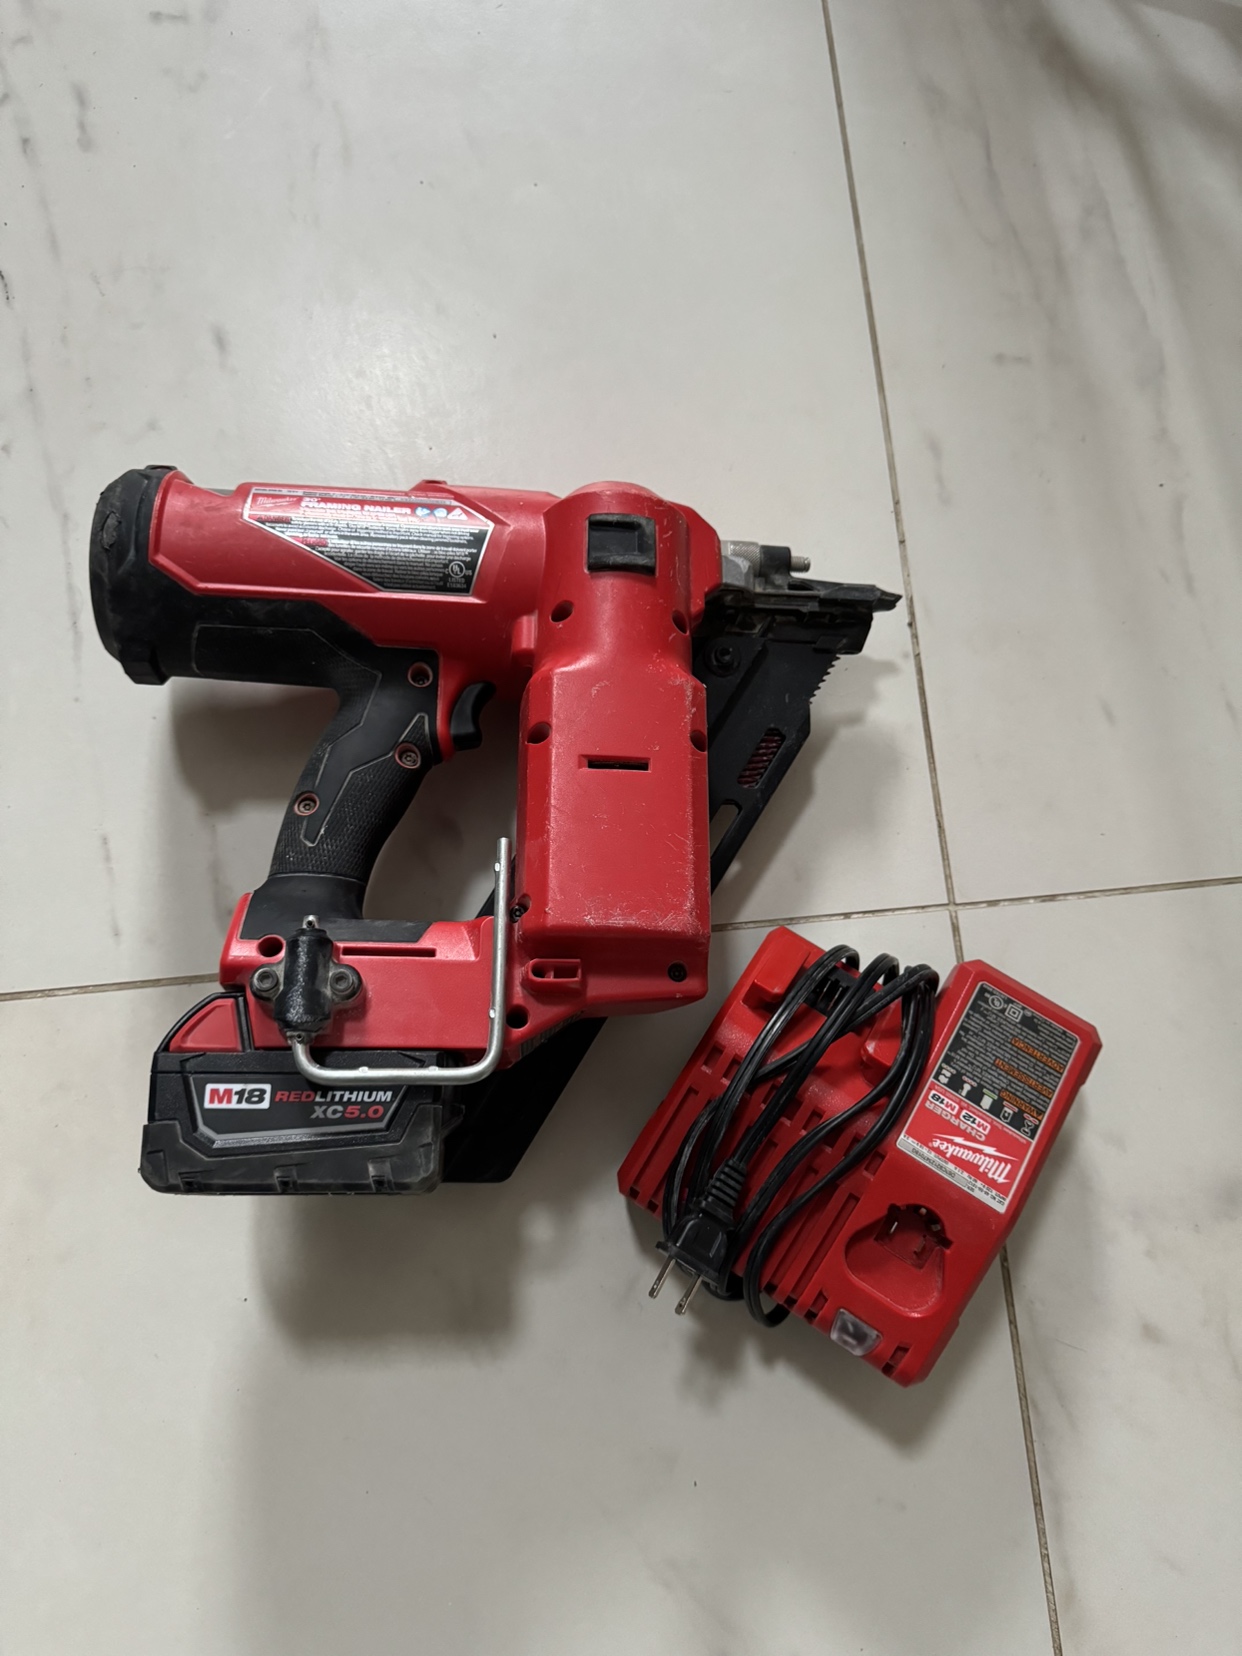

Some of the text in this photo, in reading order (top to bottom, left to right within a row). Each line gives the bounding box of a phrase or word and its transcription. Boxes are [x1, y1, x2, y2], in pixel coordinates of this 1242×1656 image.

[301, 501, 411, 515] FRAMING NAILER
[209, 1088, 393, 1104] M18 REDLITHIUM
[999, 1089, 1035, 1115] WARNING
[310, 1104, 385, 1120] XC5.0
[924, 1099, 986, 1142] CHARGER
[930, 1092, 988, 1131] M12 M18
[930, 1138, 1012, 1183] Milwaukee
